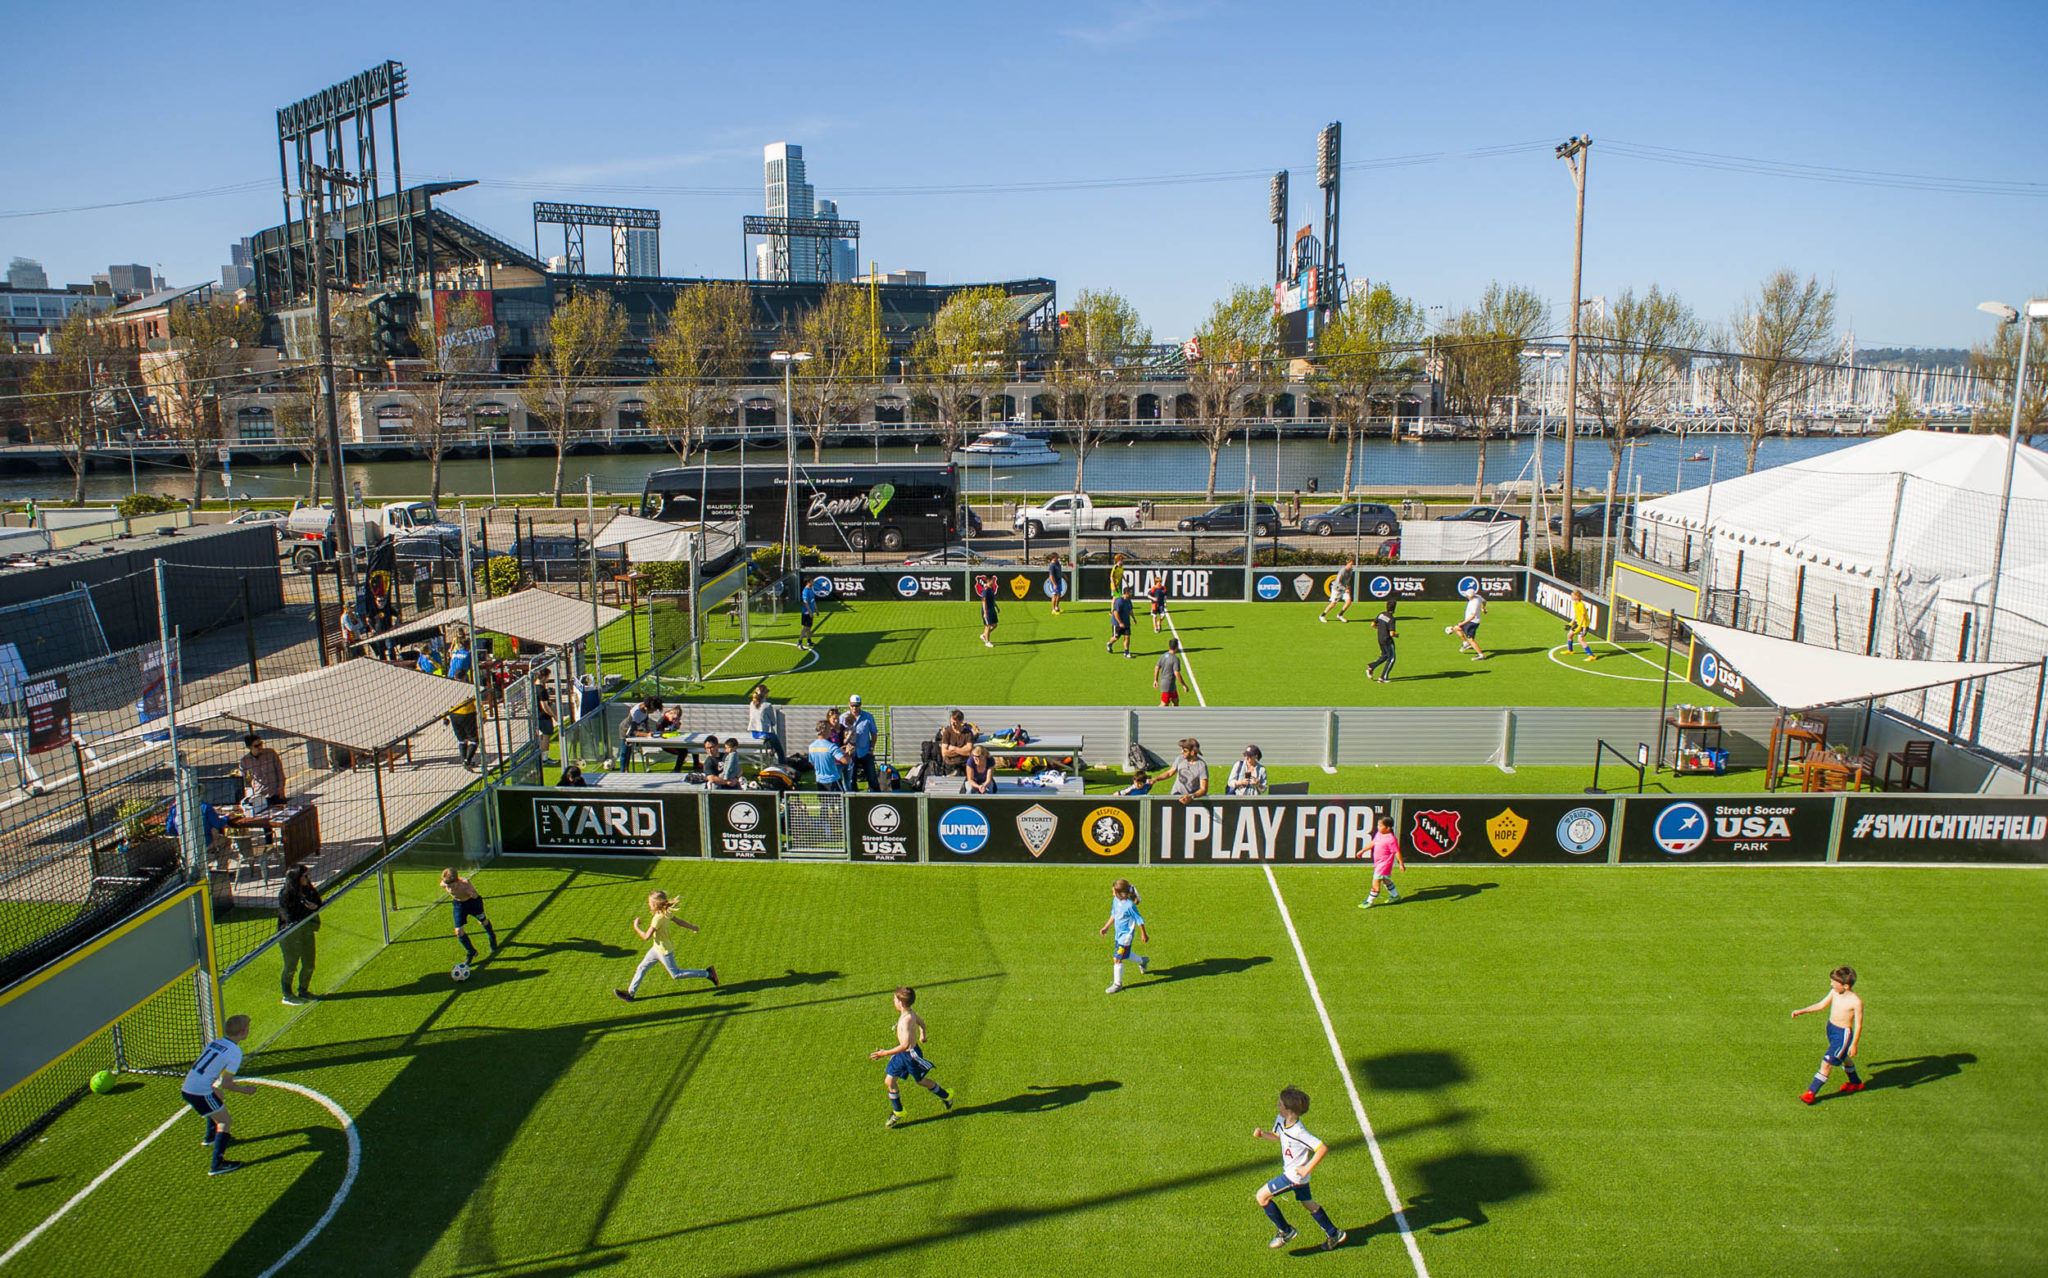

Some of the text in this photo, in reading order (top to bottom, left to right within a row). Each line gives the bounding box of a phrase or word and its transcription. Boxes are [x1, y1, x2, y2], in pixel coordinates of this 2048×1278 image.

[834, 582, 865, 591] USA
[920, 582, 952, 591] USA
[1172, 570, 1209, 597] FOR
[1393, 582, 1425, 591] USA
[1481, 582, 1512, 591] USA
[1719, 668, 1744, 692] USA
[25, 680, 57, 697] COMPETE
[1096, 807, 1120, 816] RESPECT
[1569, 810, 1588, 820] PRIDE
[1715, 806, 1796, 815] Street Soccer
[541, 805, 657, 836] THE YARD
[946, 824, 980, 836] UNITY
[1161, 806, 1173, 859] I
[1184, 806, 1286, 859] PLAY
[1294, 806, 1374, 859] FOR
[1422, 818, 1449, 848] FAMILY
[1714, 817, 1792, 838] USA
[1852, 814, 2048, 840] #SWITCHTHEFIELD
[1494, 830, 1518, 840] HOPE
[722, 839, 766, 851] USA
[862, 841, 907, 854] USA
[1733, 842, 1769, 851] PARK
[192, 1048, 219, 1075] 11
